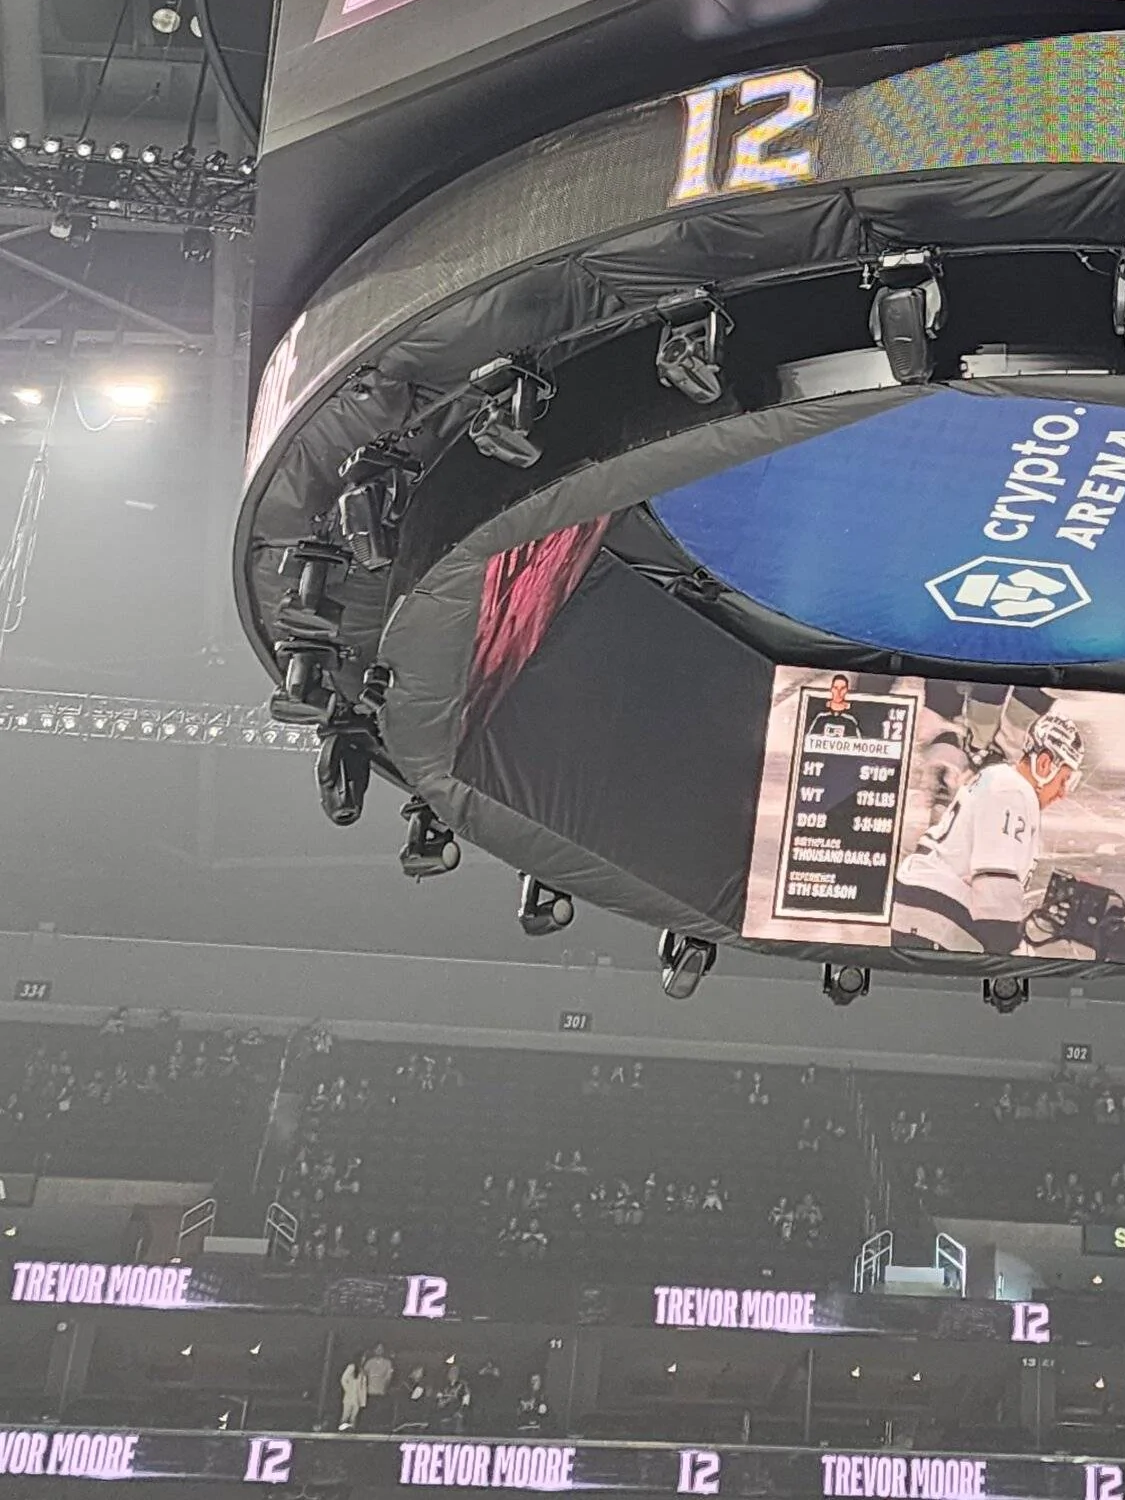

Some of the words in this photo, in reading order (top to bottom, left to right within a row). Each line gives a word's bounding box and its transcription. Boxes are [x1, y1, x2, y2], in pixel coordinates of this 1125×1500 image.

[669, 67, 821, 206] 12
[983, 407, 1087, 542] crypto.
[809, 738, 849, 751] TREVOR
[853, 741, 890, 755] MOORE
[882, 721, 902, 740] 12
[803, 761, 824, 776] HT
[801, 787, 824, 802] WT
[1001, 810, 1027, 842] 12
[564, 1015, 586, 1029] 301
[1066, 1047, 1087, 1060] 302
[12, 1262, 106, 1303] TREVOR
[105, 1264, 193, 1304] MOORE
[404, 1275, 448, 1317] 12
[654, 1286, 738, 1327] TREVOR
[739, 1290, 816, 1330] MOORE
[1010, 1302, 1050, 1343] 12
[46, 1432, 138, 1475] MOORE
[243, 1438, 292, 1482] 12
[399, 1444, 490, 1486] TREVOR
[491, 1446, 576, 1488] MOORE
[677, 1450, 721, 1494] 12
[822, 1455, 908, 1497] TREVOR
[910, 1459, 987, 1499] MOORE
[1083, 1464, 1125, 1500] 12
